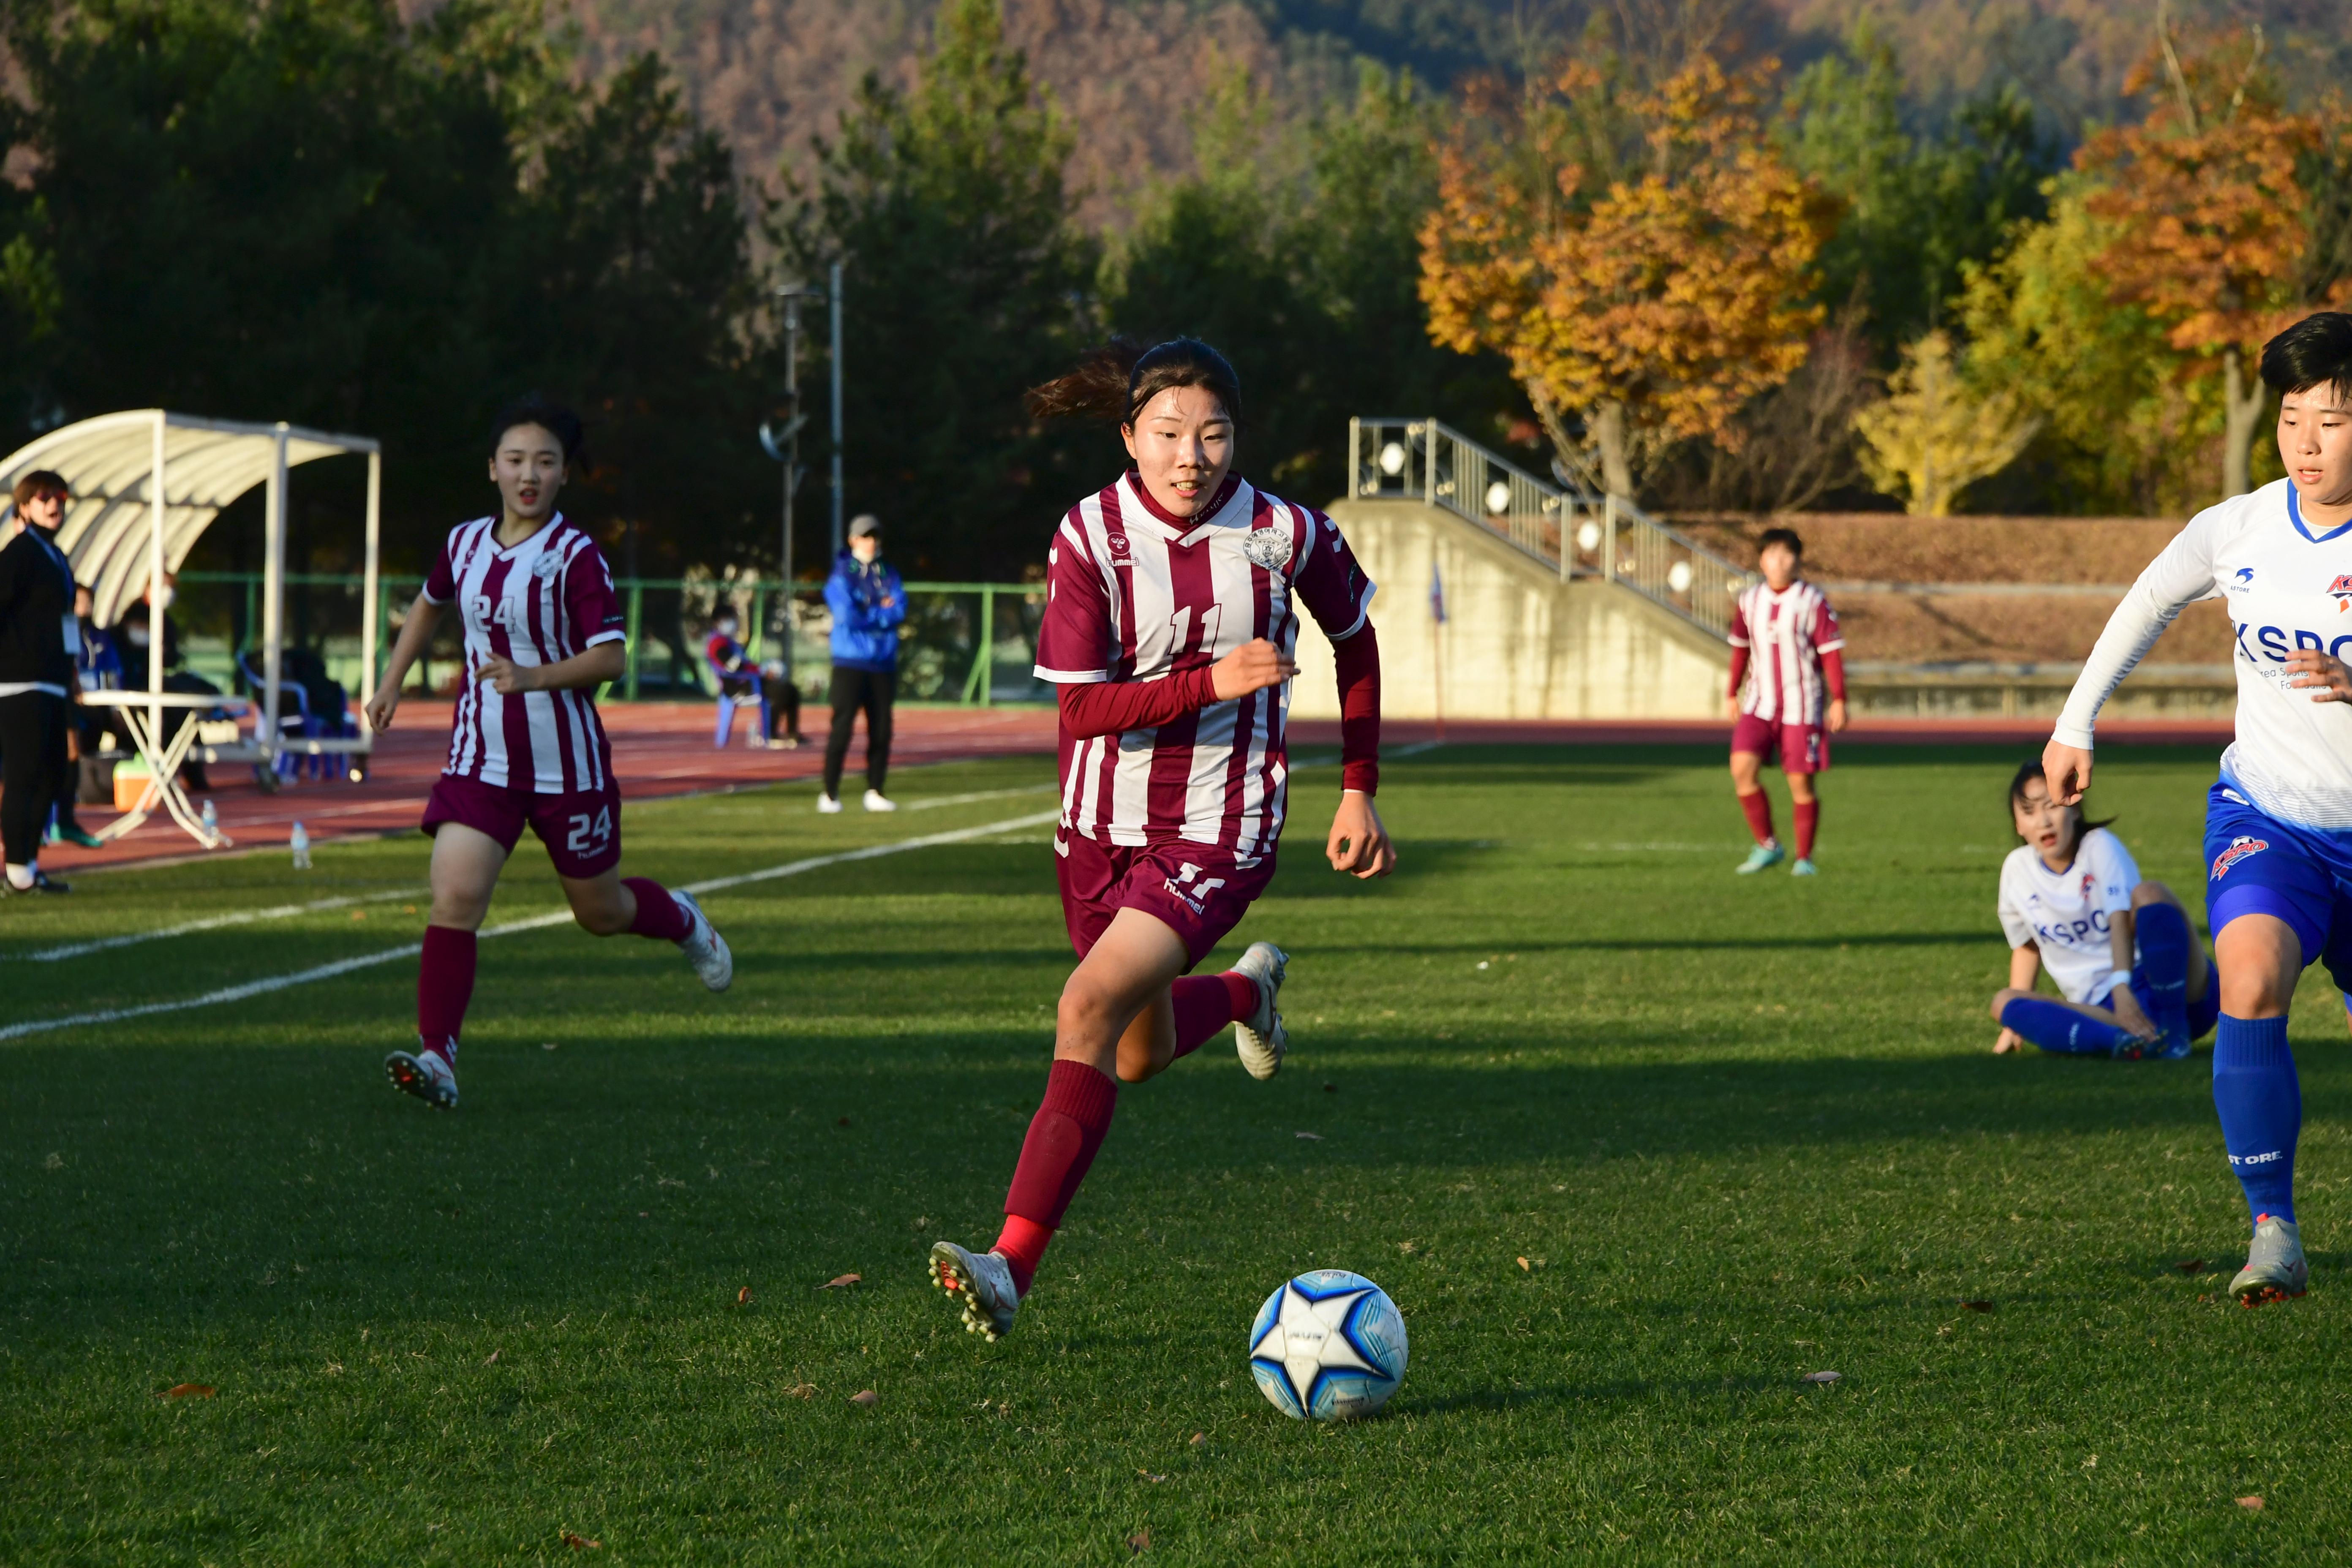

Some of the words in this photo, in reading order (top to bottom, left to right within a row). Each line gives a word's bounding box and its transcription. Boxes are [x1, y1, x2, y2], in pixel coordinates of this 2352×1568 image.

[1105, 557, 1140, 567] hummel
[472, 595, 516, 633] 24
[1167, 603, 1222, 656] 11
[568, 804, 612, 851] 24
[1163, 877, 1205, 916] hummel
